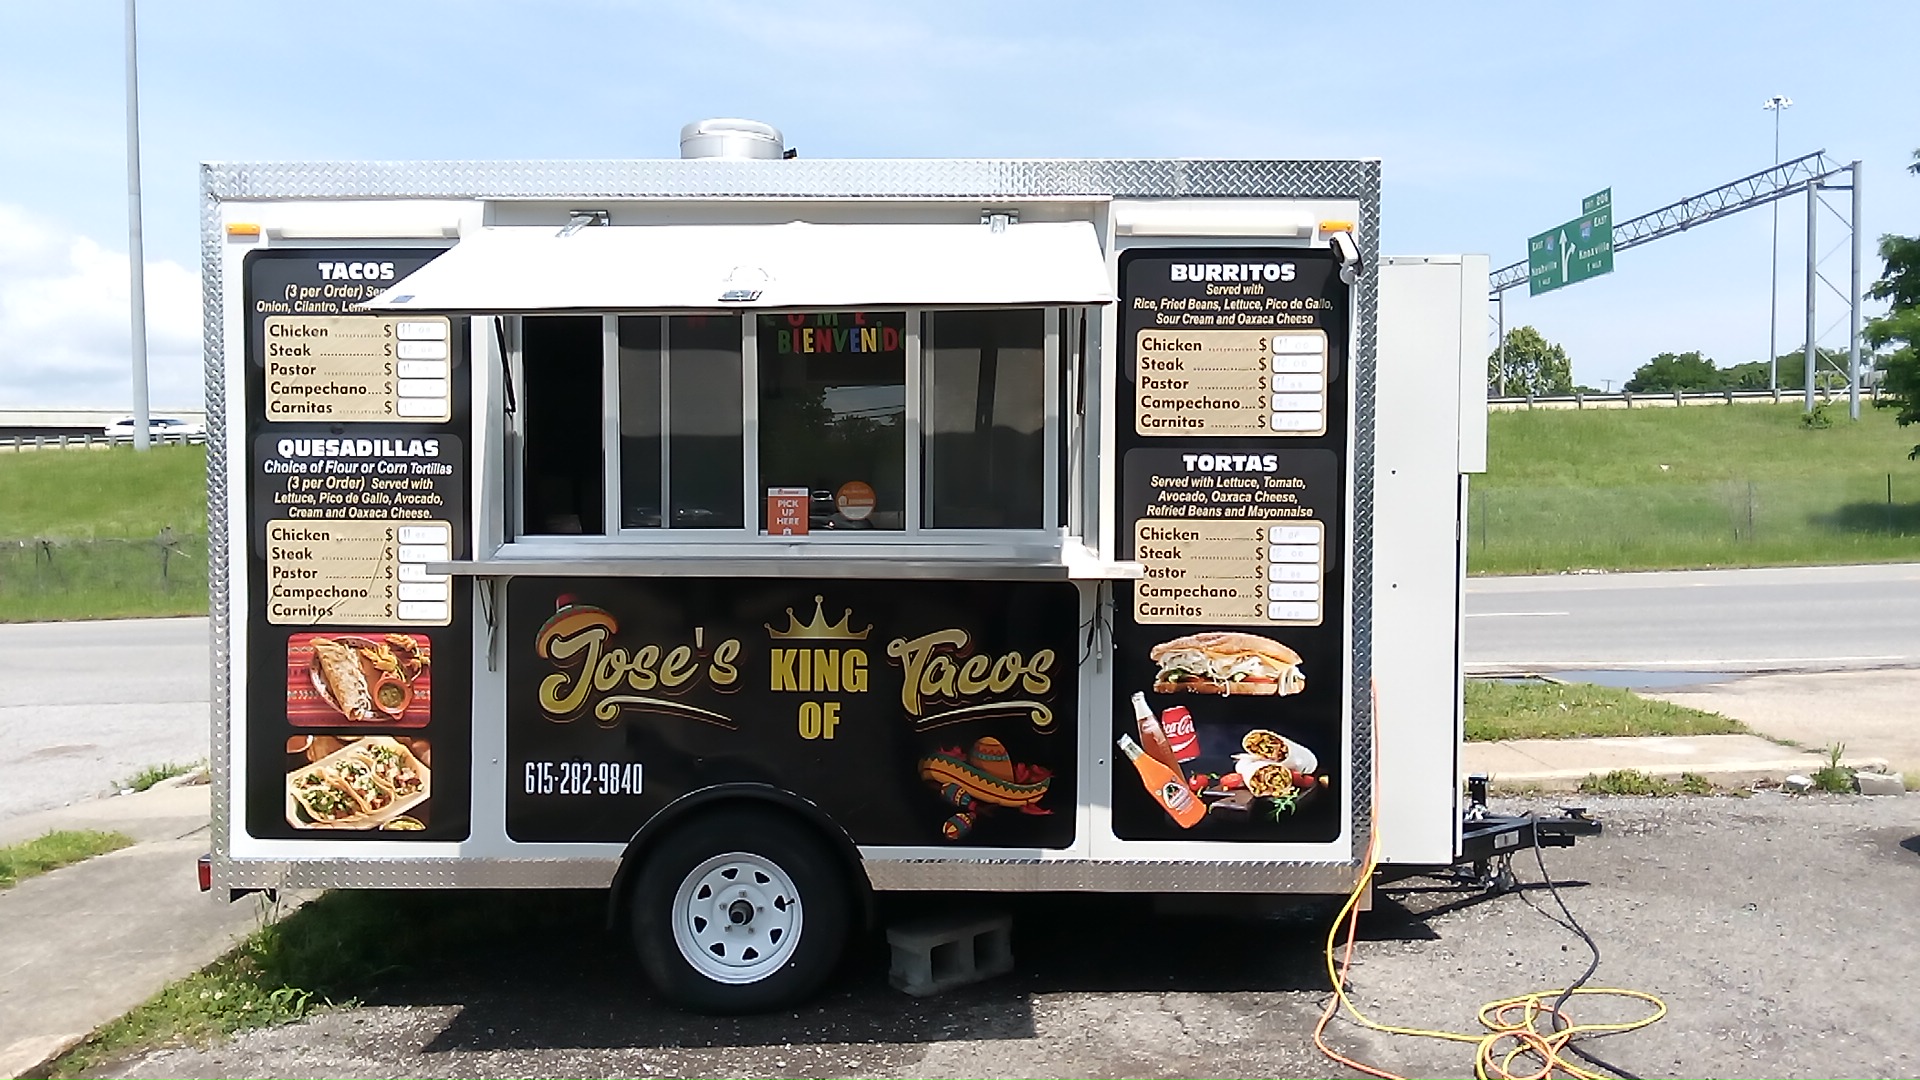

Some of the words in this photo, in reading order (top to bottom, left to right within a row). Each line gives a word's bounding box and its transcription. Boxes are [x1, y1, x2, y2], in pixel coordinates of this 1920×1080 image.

[318, 262, 395, 280] TACOS
[1171, 263, 1295, 282] BURRITOS
[285, 284, 297, 300] (3
[300, 286, 322, 299] per
[324, 285, 363, 300] Order)
[1206, 283, 1241, 295] Served
[1243, 284, 1264, 295] with
[256, 301, 291, 314] Onion,
[294, 301, 338, 314] Cilantro,
[1134, 298, 1158, 311] Rice,
[1160, 298, 1186, 310] Fried
[1188, 298, 1219, 311] Beans,
[1224, 298, 1263, 311] Lettuce,
[1266, 299, 1287, 310] Pico
[1290, 299, 1303, 310] de
[1305, 299, 1333, 311] Gallo,
[1156, 314, 1180, 325] Sour
[1182, 314, 1214, 325] Cream
[1216, 314, 1235, 325] and
[1237, 314, 1274, 325] Oaxaca
[1277, 314, 1314, 325] Cheese
[269, 324, 328, 337] Chicken
[270, 343, 311, 356] Steak
[1142, 337, 1202, 351] Chicken
[270, 363, 316, 375] Pastor
[1141, 357, 1184, 371] Steak
[270, 382, 367, 397] Campechano
[1142, 376, 1189, 390] Pastor
[270, 401, 332, 413] Carnitas
[1141, 395, 1240, 411] Campechano
[1141, 414, 1205, 428] Carnitas
[278, 439, 439, 458] QUESADILLAS
[264, 460, 307, 474] Choice
[309, 460, 323, 474] of
[325, 461, 359, 474] Flour
[361, 462, 375, 474] or
[377, 461, 407, 474] Corn
[411, 462, 452, 475] Tortillas
[1183, 455, 1278, 472] TORTAS
[287, 477, 299, 490] (3
[302, 478, 323, 491] per
[326, 477, 365, 491] Order)
[371, 478, 409, 490] Served
[411, 478, 433, 490] with
[1151, 476, 1190, 488] Served
[1192, 477, 1214, 488] with
[1217, 477, 1260, 489] Lettuce,
[1264, 477, 1306, 489] Tomato,
[274, 493, 316, 505] Lettuce,
[319, 493, 343, 504] Pico
[346, 493, 359, 504] de
[362, 493, 392, 505] Gallo,
[394, 493, 443, 506] Avocado,
[777, 500, 798, 508] PICK
[1158, 491, 1209, 504] Avocado,
[1211, 491, 1251, 503] Oaxaca
[1254, 491, 1298, 504] Cheese,
[289, 507, 323, 518] Cream
[325, 507, 346, 518] and
[349, 507, 387, 519] Oaxaca
[391, 507, 433, 519] Cheese.
[1147, 505, 1186, 517] Refried
[1188, 506, 1222, 517] Beans
[1224, 506, 1246, 517] and
[1248, 506, 1313, 519] Mayonnaise
[272, 528, 330, 541] Chicken
[1140, 527, 1199, 541] Chicken
[272, 547, 313, 560] Steak
[1140, 546, 1181, 560] Steak
[273, 567, 318, 579] Pastor
[273, 586, 368, 601] Campechano
[1139, 584, 1237, 599] Campechano
[272, 604, 334, 617] Carnitas
[1139, 603, 1202, 617] Carnitas
[770, 648, 868, 693] KING
[887, 628, 1056, 716] Tacos
[799, 701, 841, 740] OF
